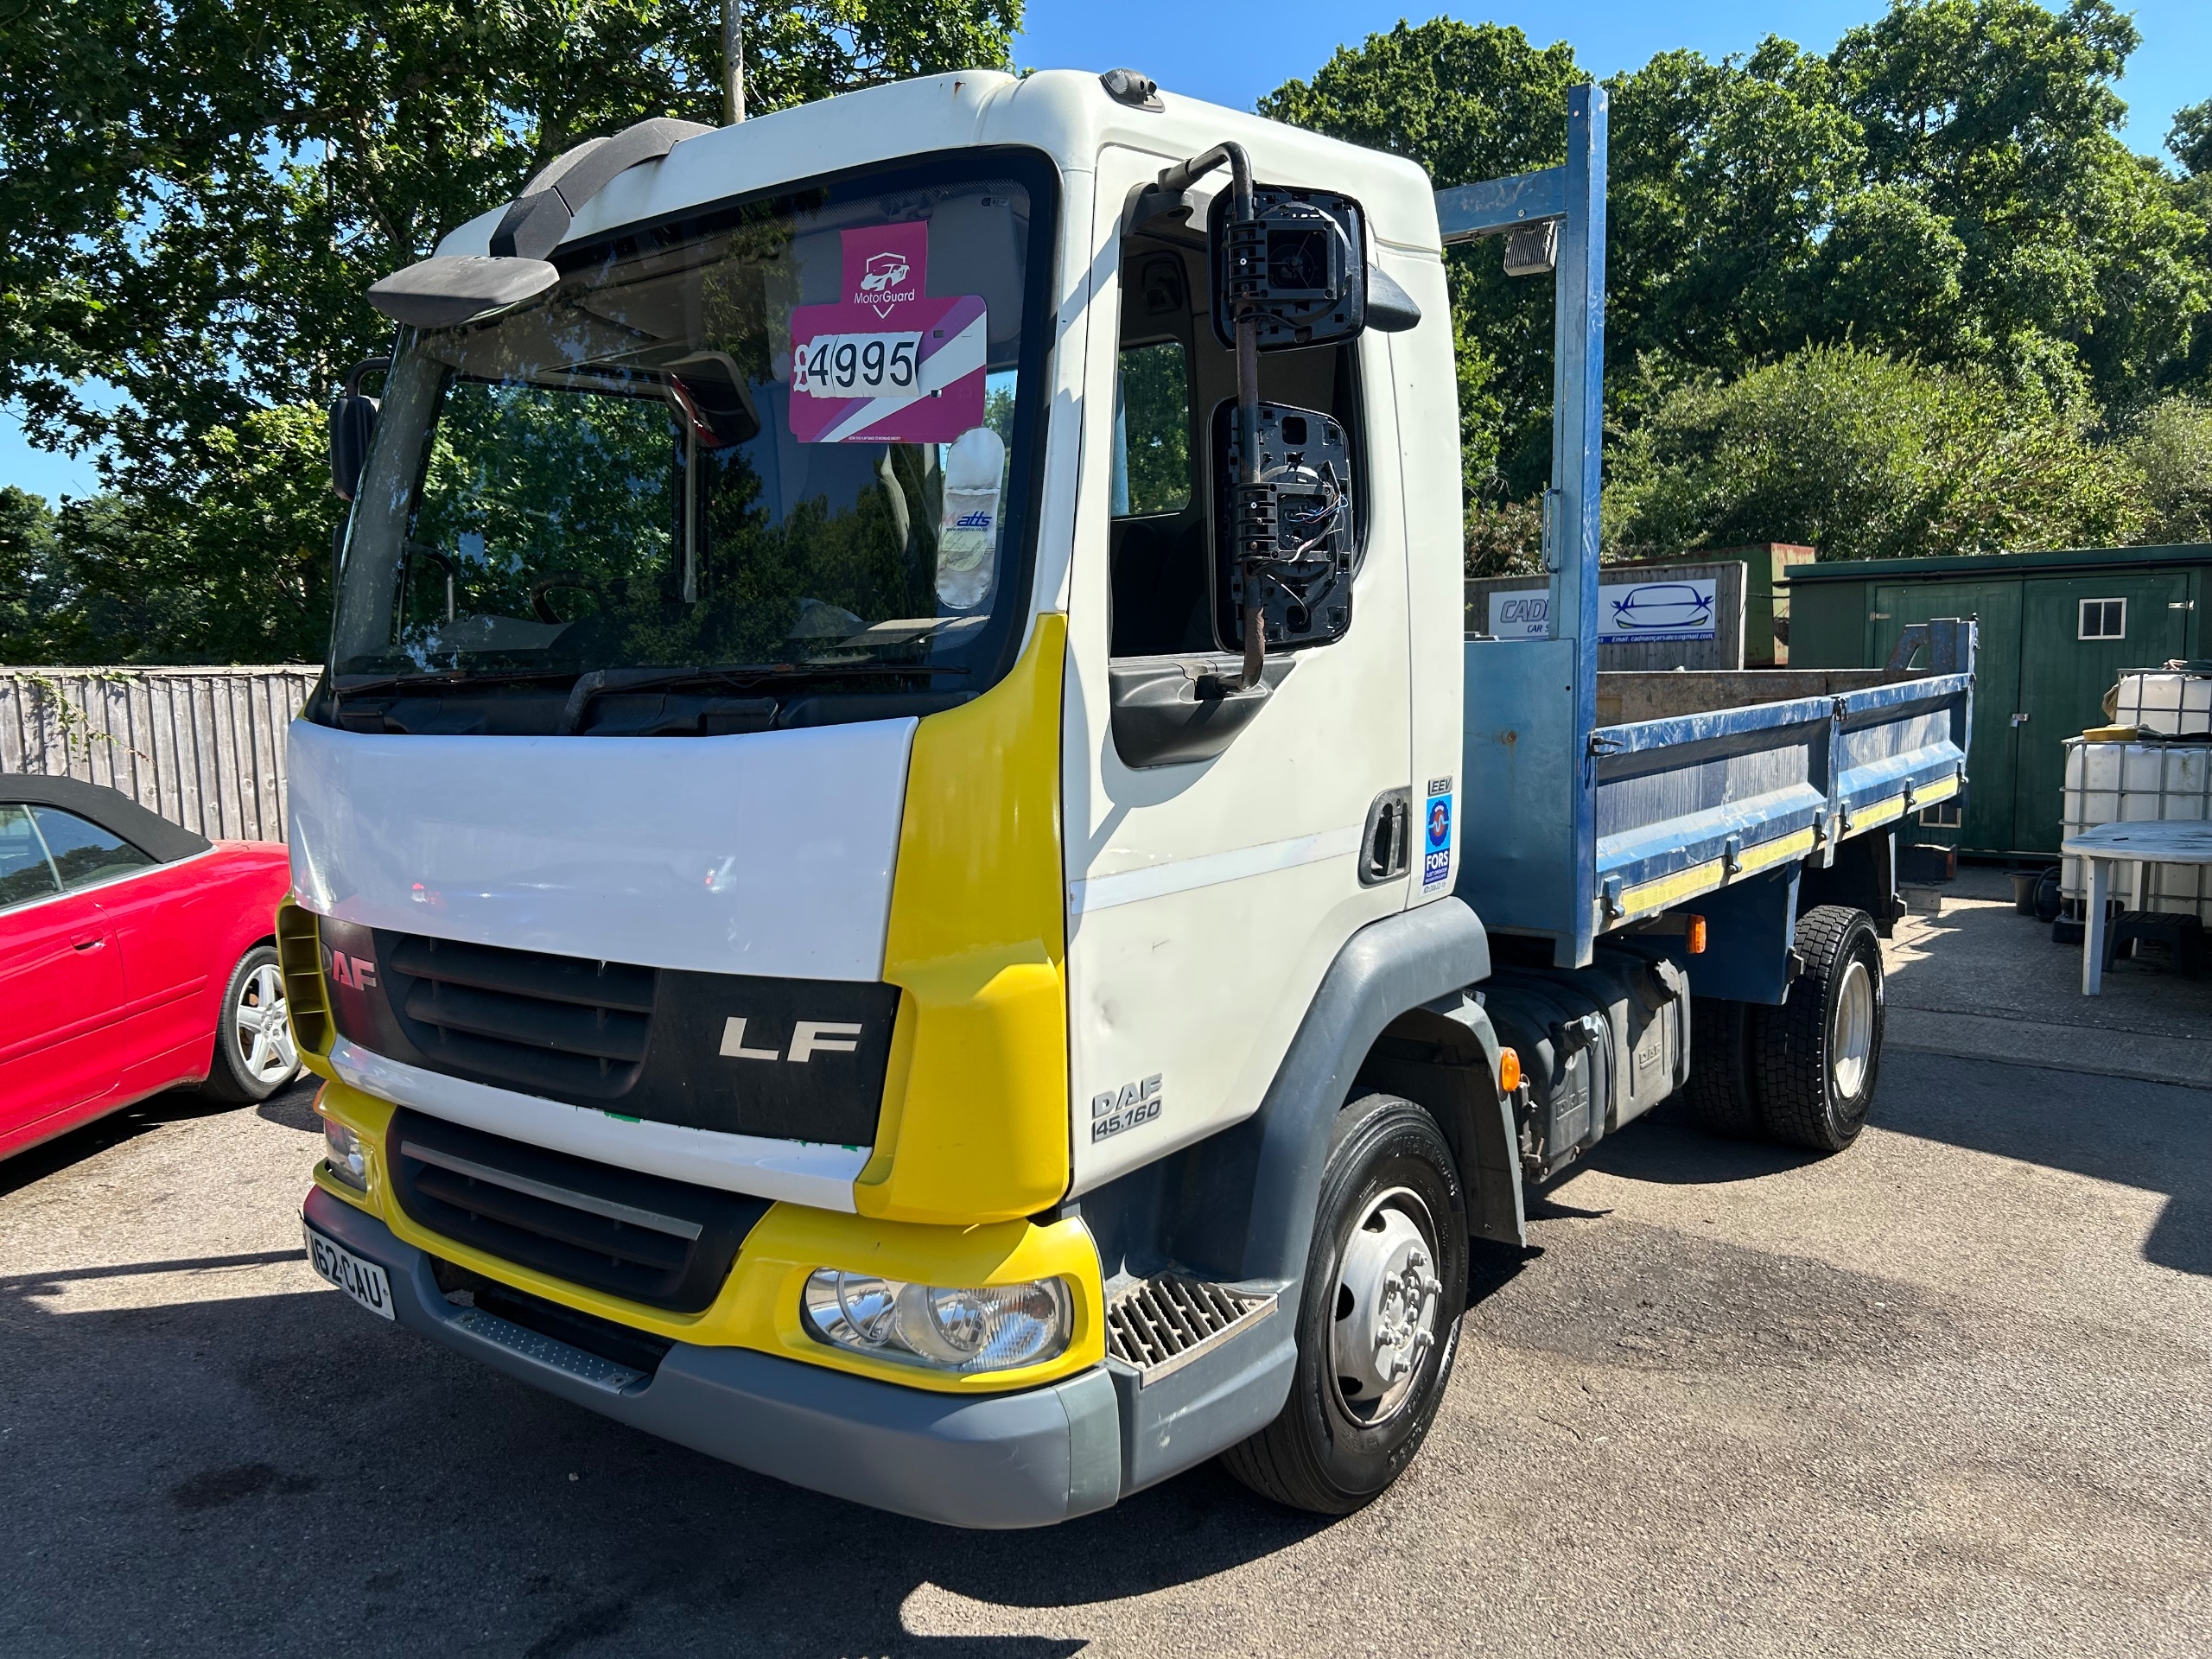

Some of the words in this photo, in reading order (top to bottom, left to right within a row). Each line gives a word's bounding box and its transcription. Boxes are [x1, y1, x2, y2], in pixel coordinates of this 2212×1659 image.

[854, 289, 915, 304] MotorGuard
[793, 340, 915, 392] £4995
[1527, 624, 1543, 633] CAR
[1431, 779, 1452, 792] EEV
[1426, 850, 1449, 872] FORS
[720, 1016, 862, 1063] LF
[1639, 1042, 1661, 1065] DAF
[1091, 1072, 1163, 1120] DAF
[1556, 1086, 1587, 1116] DAF
[1096, 1099, 1161, 1136] 45.160
